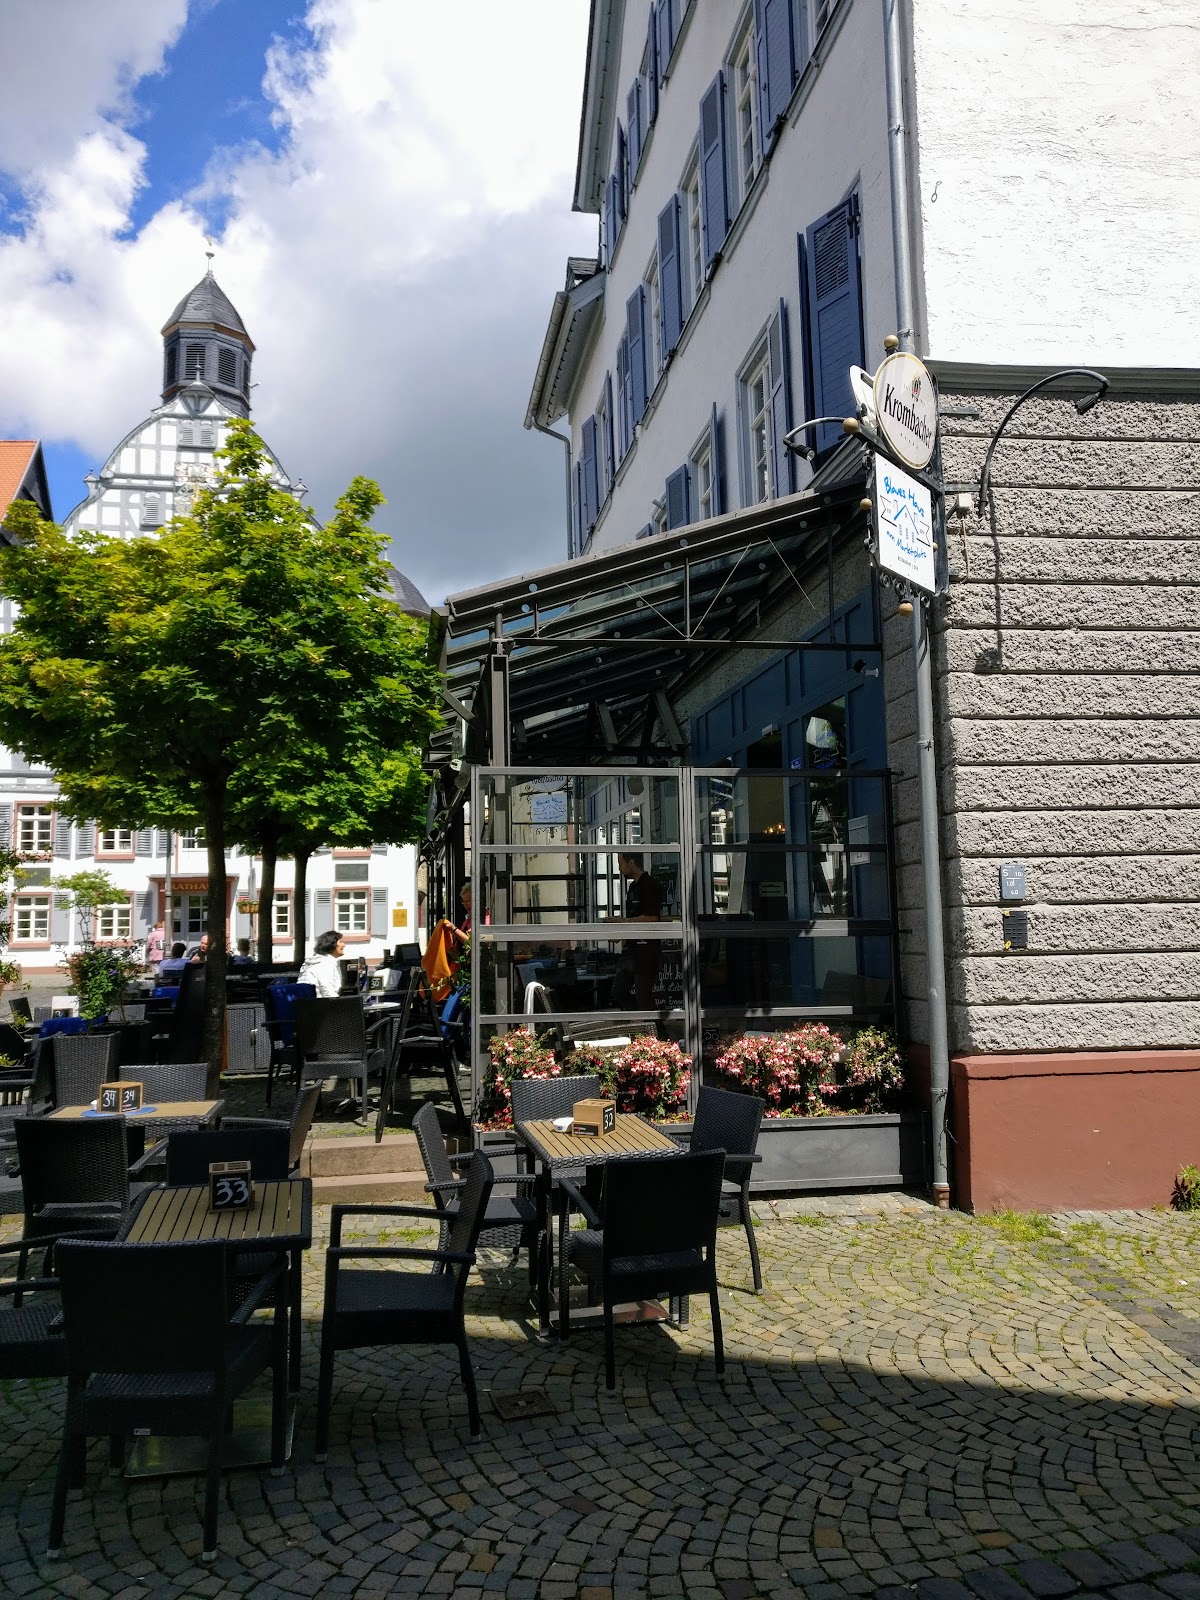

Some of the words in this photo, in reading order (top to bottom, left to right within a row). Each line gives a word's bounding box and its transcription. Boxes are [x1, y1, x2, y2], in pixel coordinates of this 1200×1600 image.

[883, 383, 932, 449] Krombacher
[908, 488, 925, 518] Haus
[1002, 868, 1009, 877] S
[102, 1092, 116, 1107] 34
[122, 1089, 135, 1103] 34
[214, 1180, 249, 1206] 33
